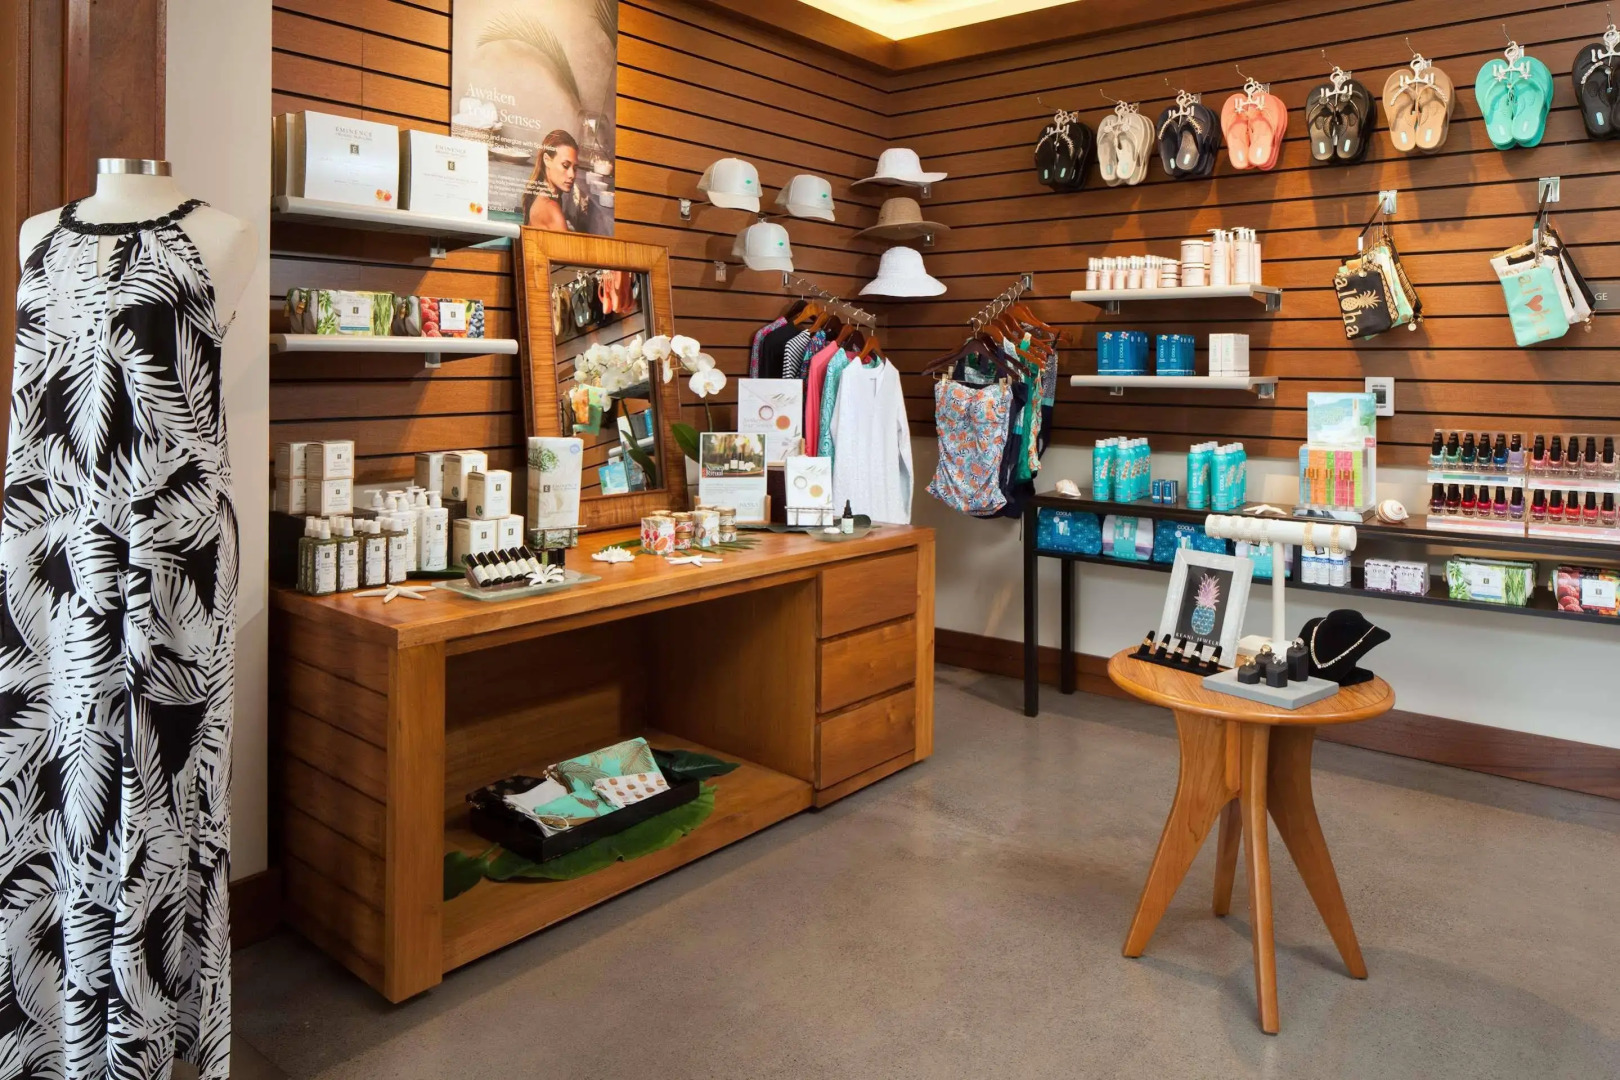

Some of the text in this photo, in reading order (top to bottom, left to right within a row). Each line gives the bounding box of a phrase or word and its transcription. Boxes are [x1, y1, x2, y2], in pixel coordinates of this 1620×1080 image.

[465, 82, 516, 106] Awaken
[500, 108, 541, 129] Senses
[335, 126, 372, 137] EMINENCE
[1196, 637, 1219, 646] JEWELR
